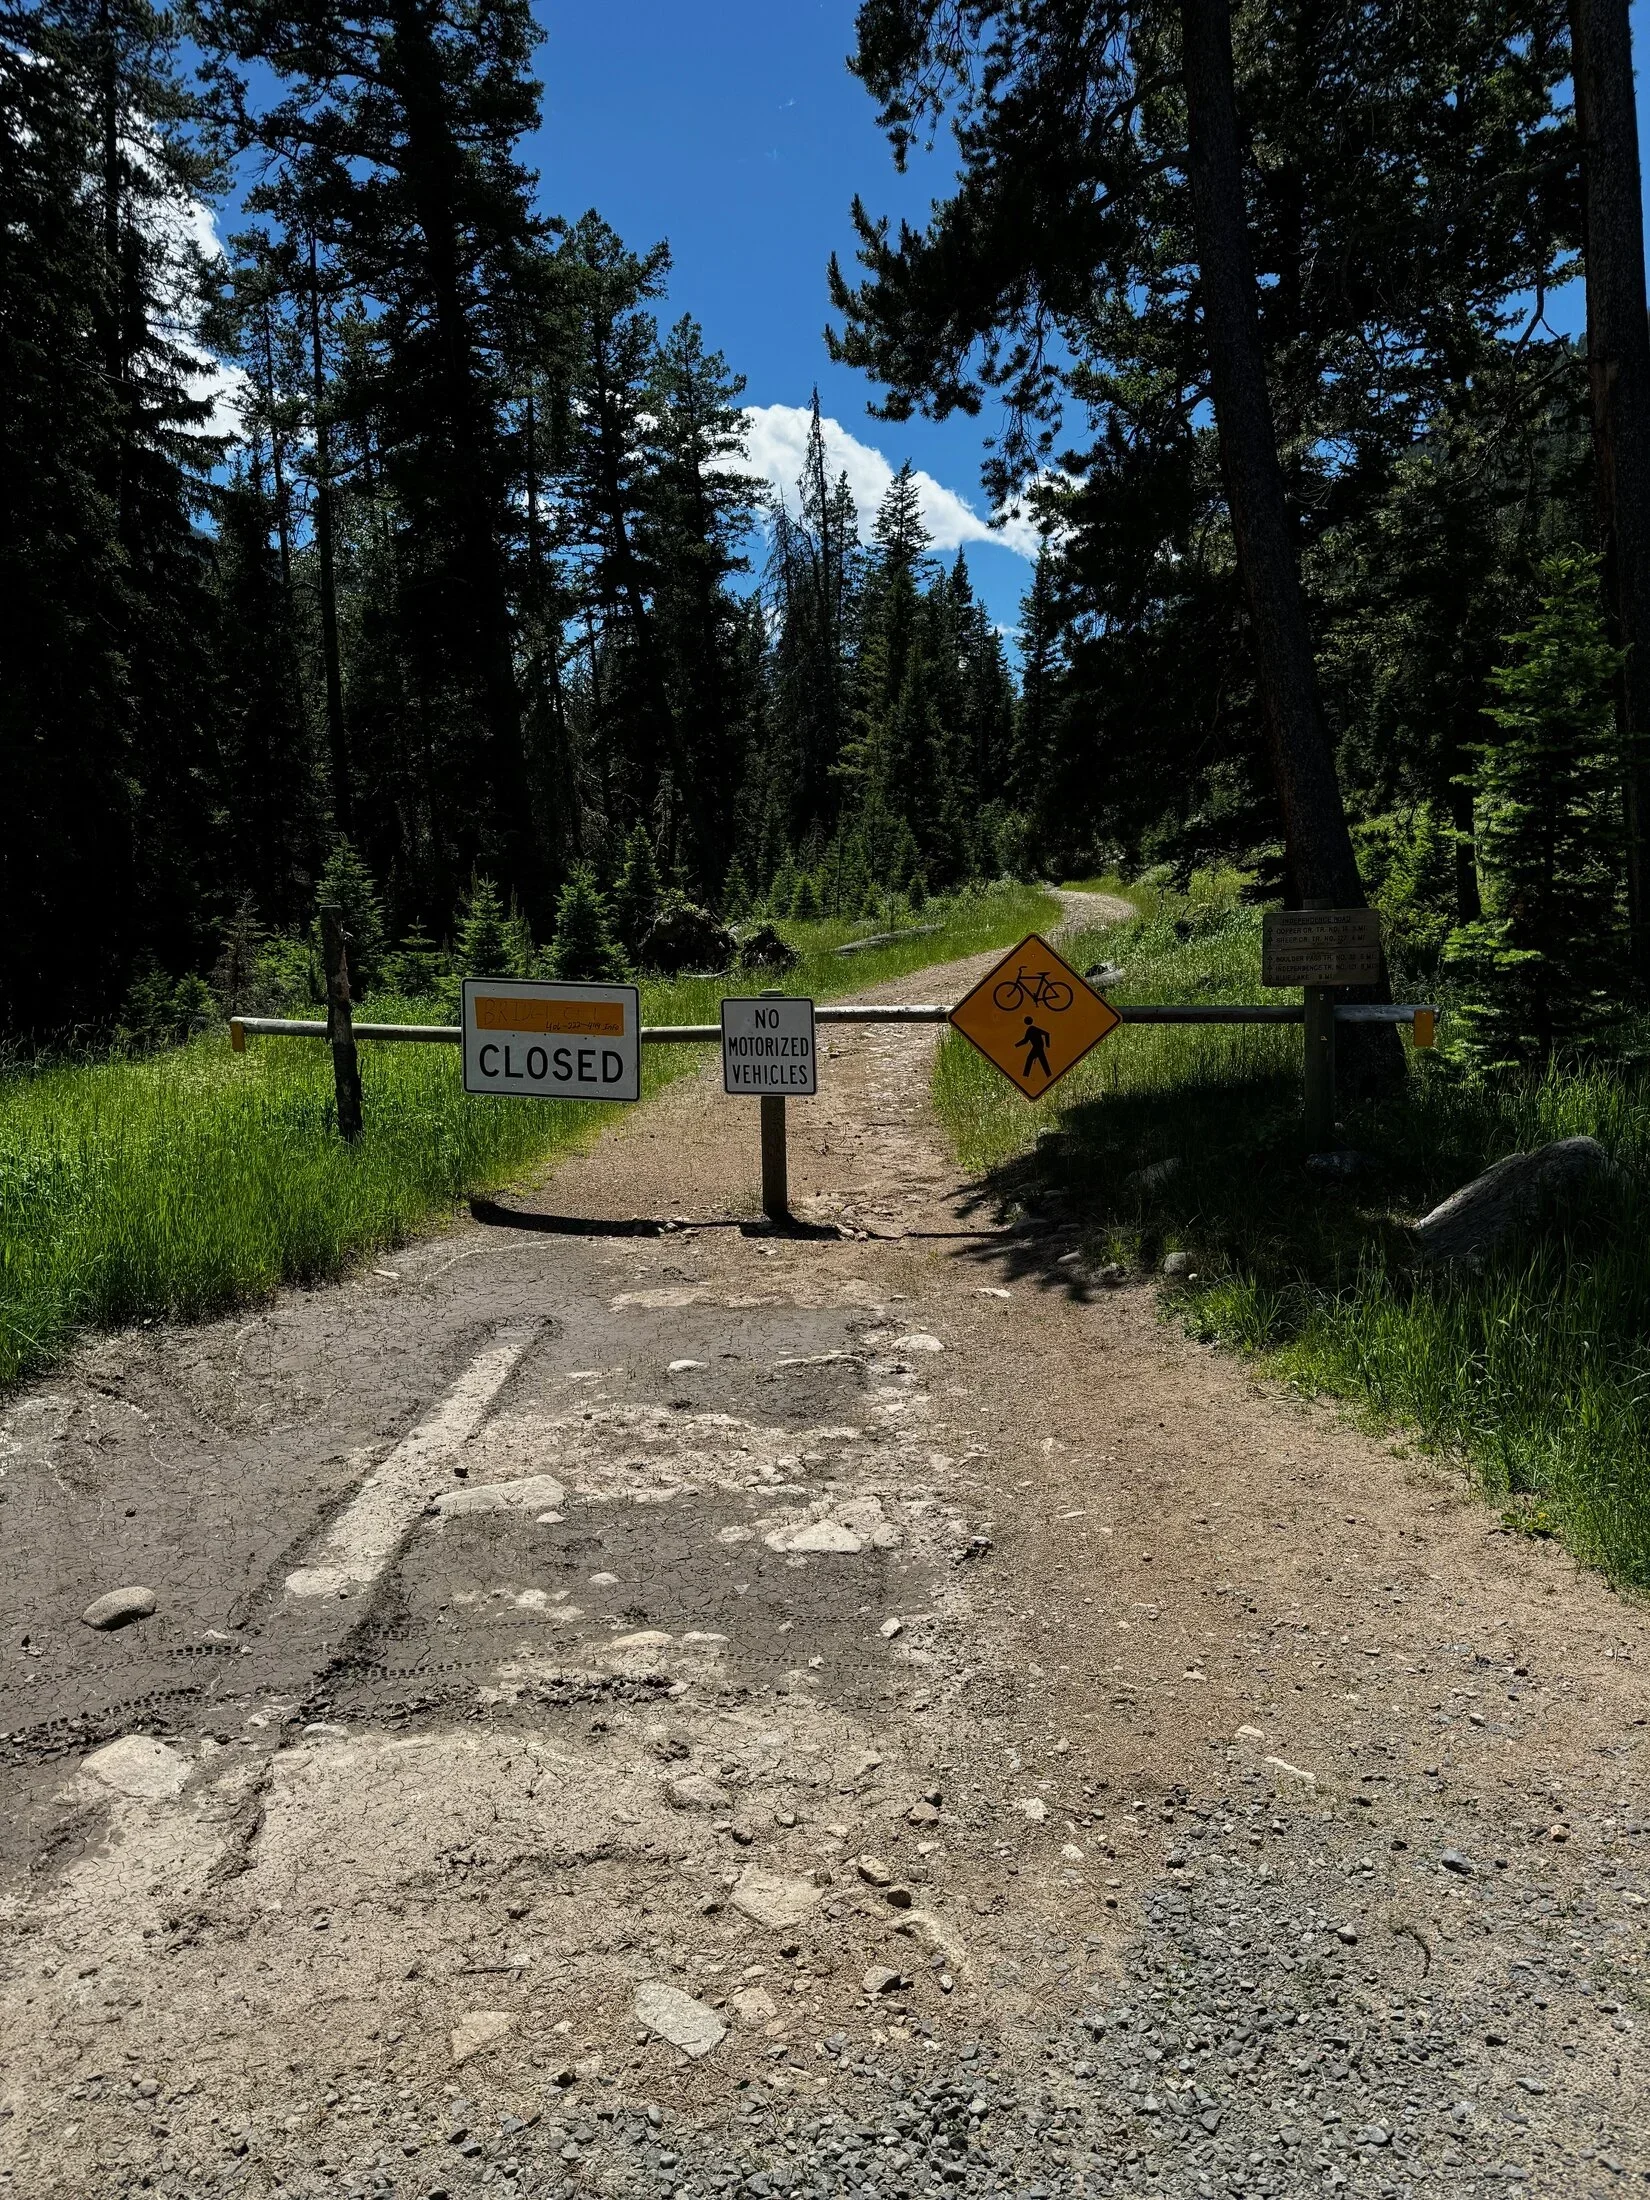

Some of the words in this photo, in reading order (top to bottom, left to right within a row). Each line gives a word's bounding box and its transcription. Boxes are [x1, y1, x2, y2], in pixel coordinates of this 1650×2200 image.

[755, 1009, 779, 1029] NO
[728, 1036, 809, 1057] MOTORIZED
[479, 1044, 623, 1083] CLOSED
[732, 1064, 808, 1085] VEHICLES
